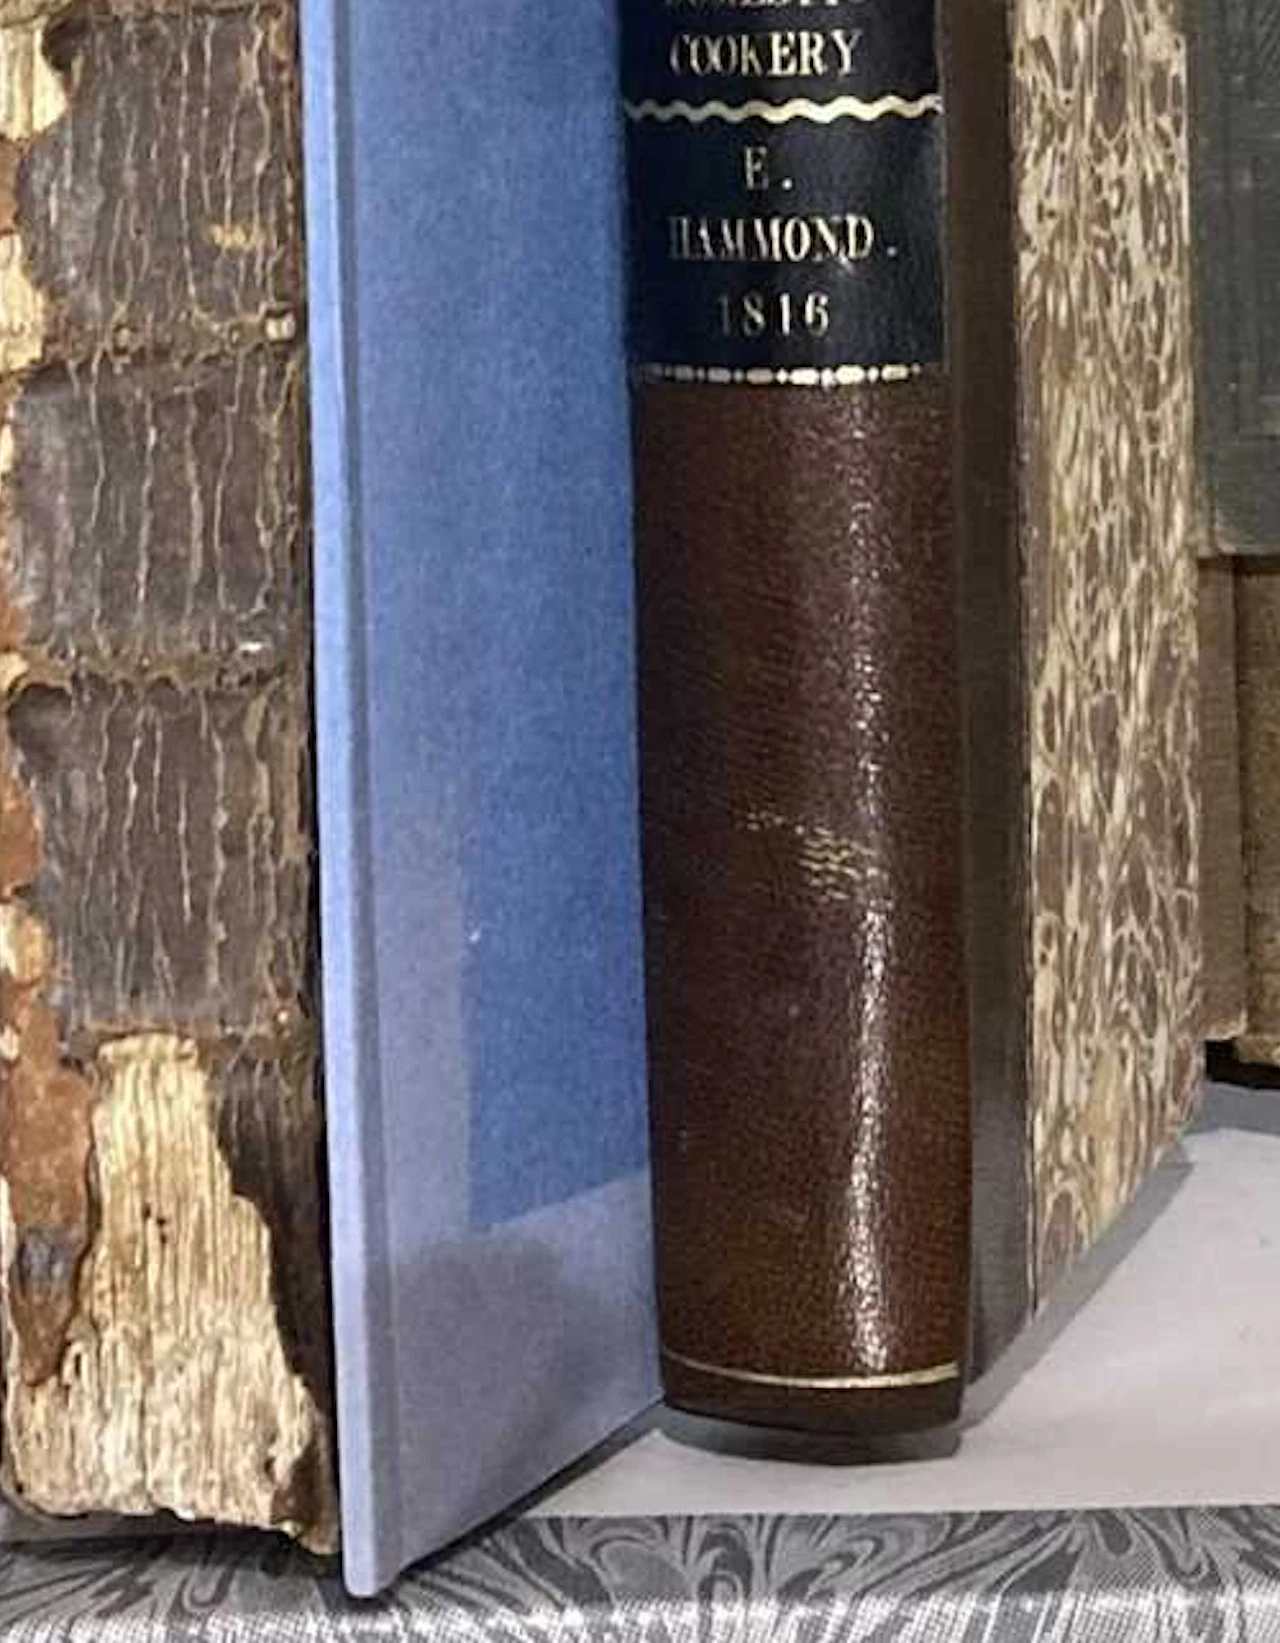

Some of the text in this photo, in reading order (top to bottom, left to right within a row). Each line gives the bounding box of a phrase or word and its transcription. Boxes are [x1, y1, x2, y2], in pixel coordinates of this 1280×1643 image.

[669, 27, 863, 78] COOKERY
[744, 146, 794, 192] E.
[720, 291, 831, 338] 1816
